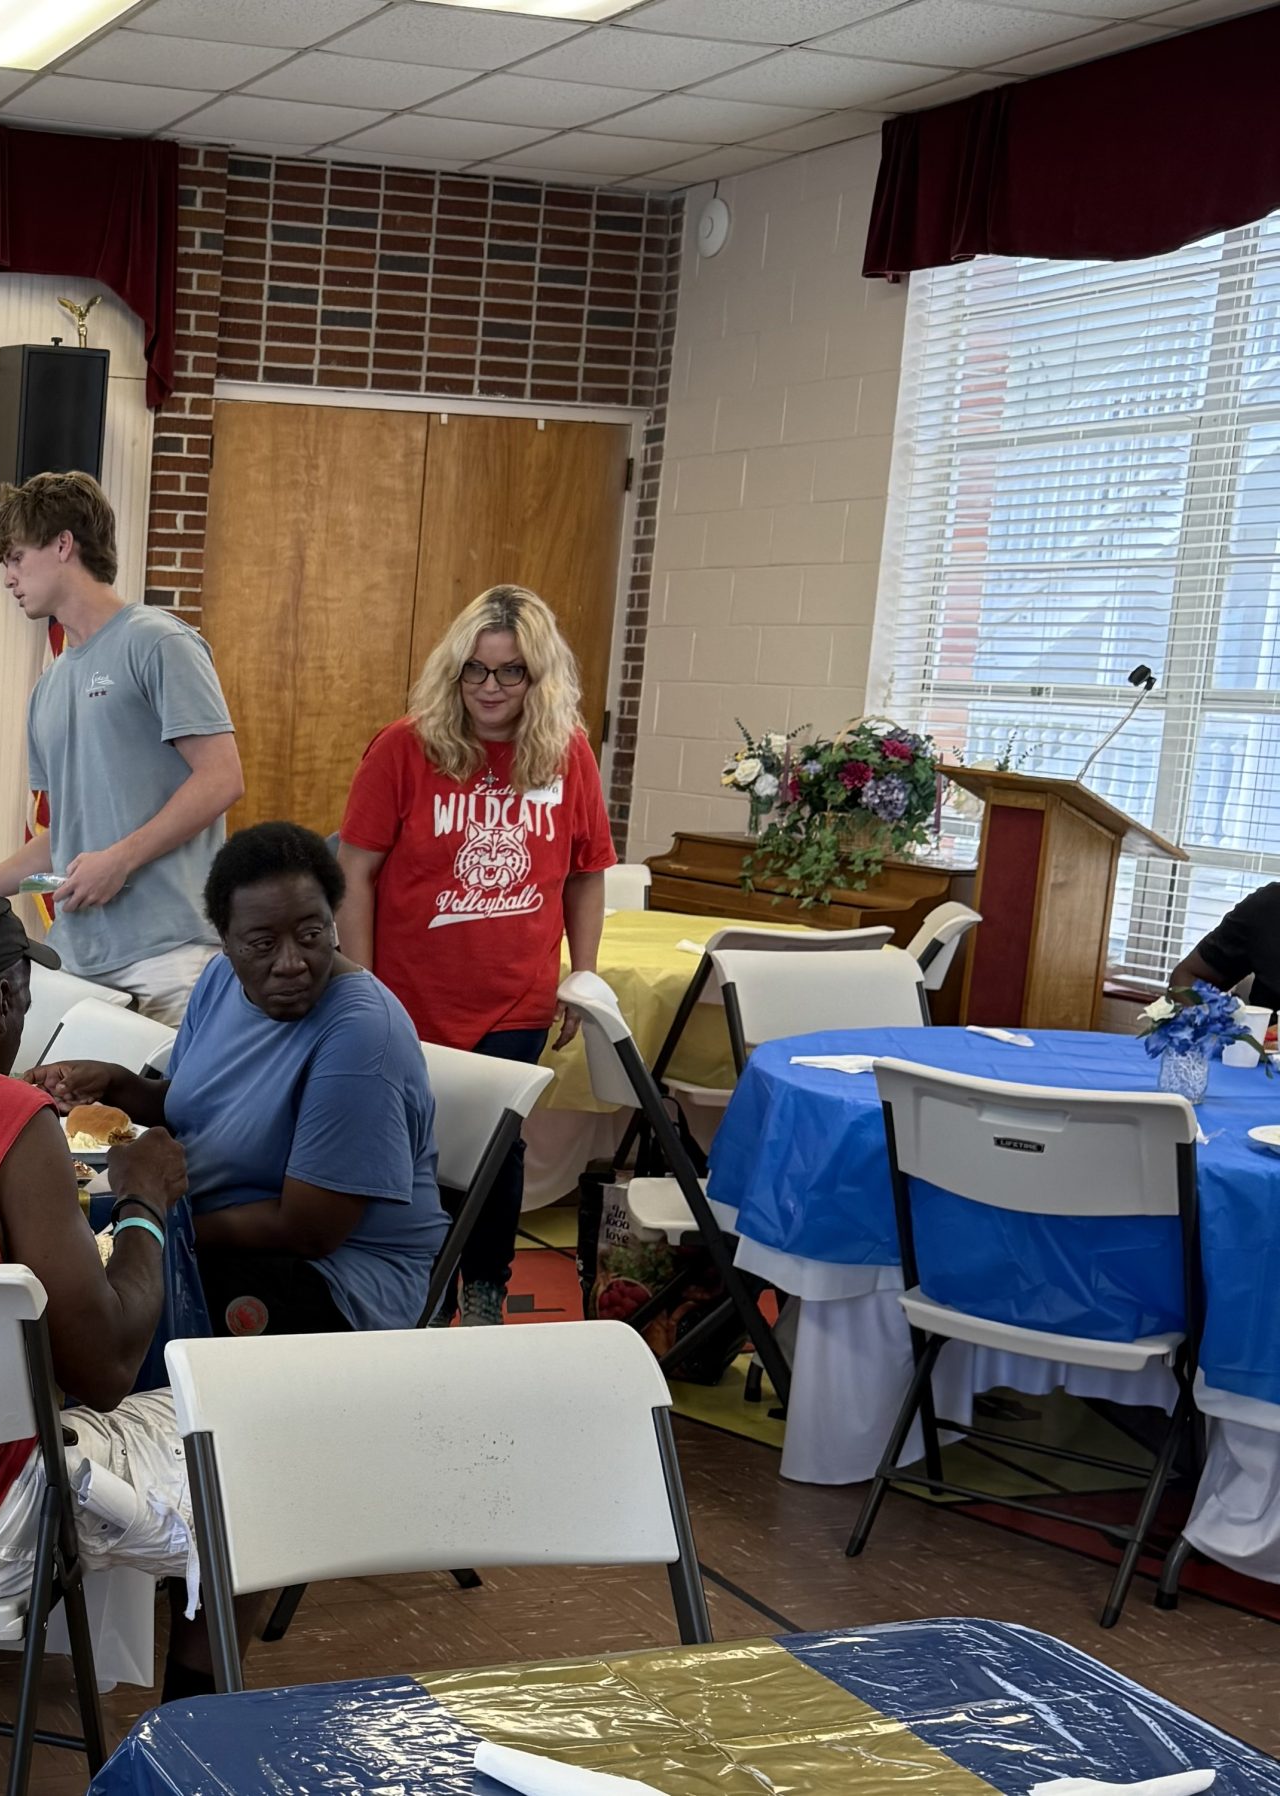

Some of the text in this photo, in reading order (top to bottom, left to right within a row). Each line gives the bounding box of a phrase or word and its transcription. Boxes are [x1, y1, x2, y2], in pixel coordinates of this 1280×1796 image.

[472, 782, 517, 798] Lady
[433, 792, 557, 843] WILDCATS
[435, 883, 544, 918] Volleyball
